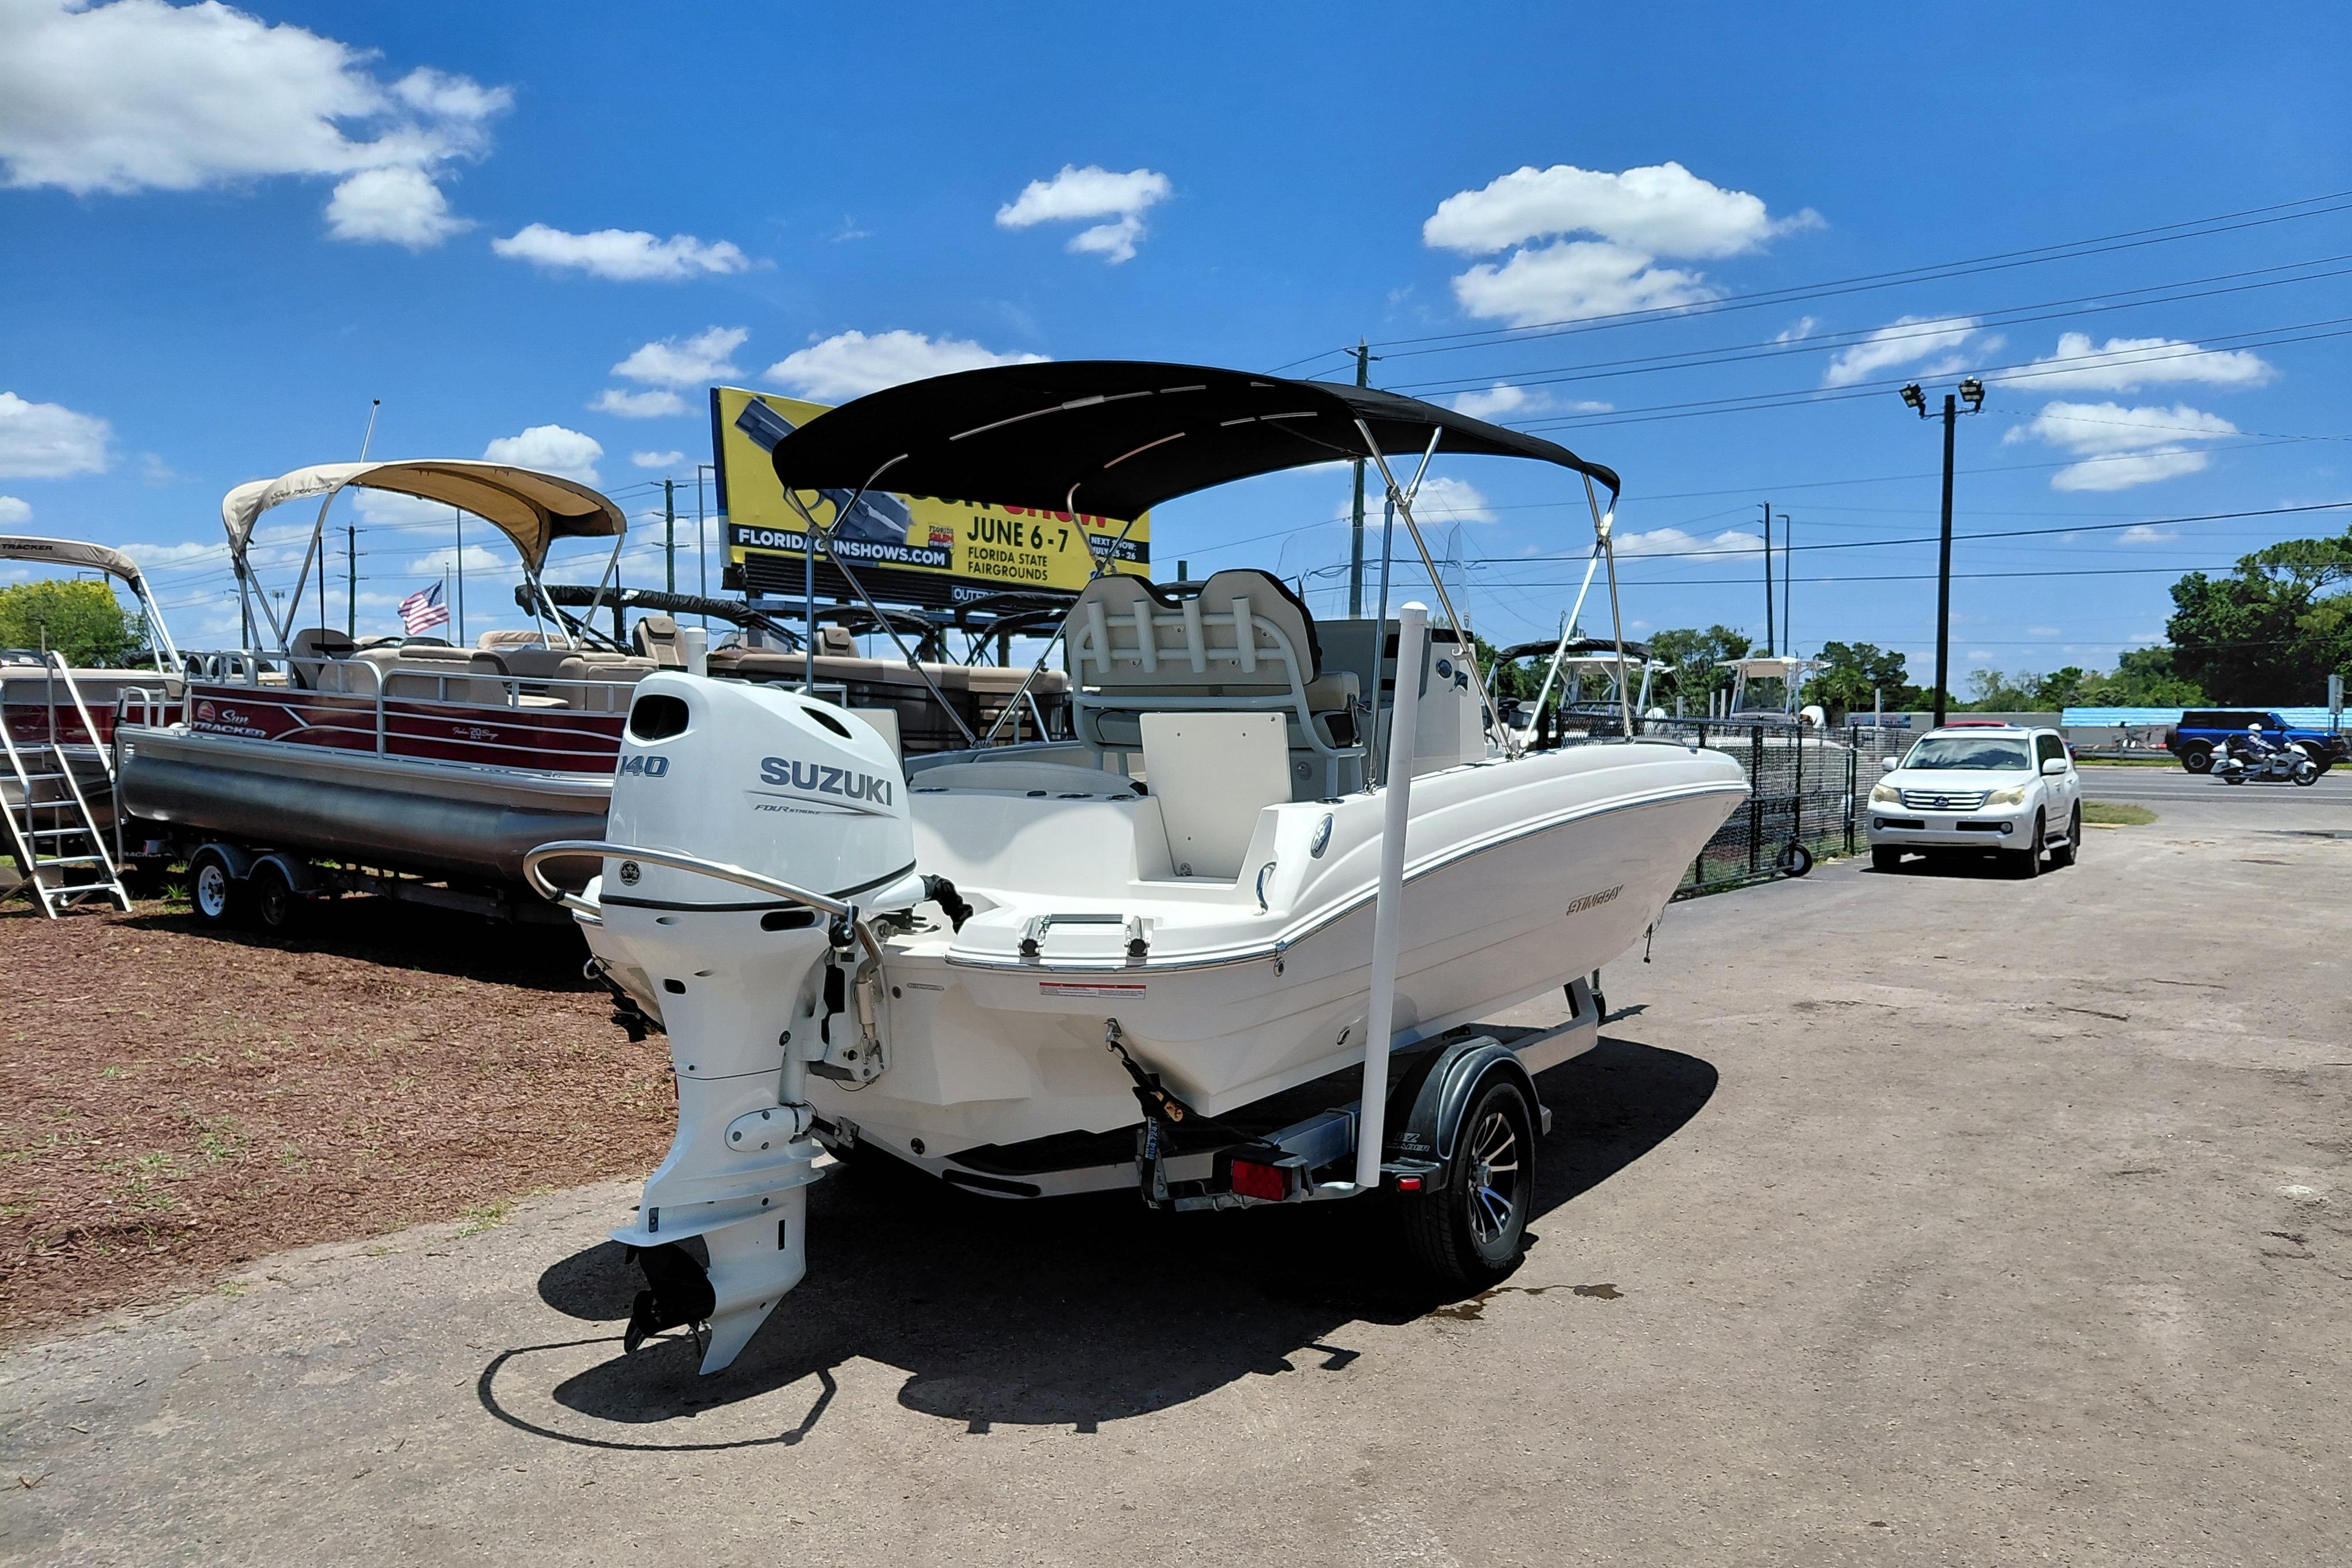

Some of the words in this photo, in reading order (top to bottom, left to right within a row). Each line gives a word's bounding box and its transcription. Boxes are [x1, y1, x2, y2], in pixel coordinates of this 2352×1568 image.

[967, 516, 1023, 547] JUNE
[1031, 525, 1043, 549] 6
[1058, 529, 1068, 552] 7
[1091, 537, 1110, 546] NEXT
[1111, 539, 1137, 551] SOW:
[968, 546, 1015, 564] FLORIDA
[1019, 553, 1047, 567] STATE
[1093, 546, 1109, 556] JULY
[1126, 551, 1136, 560] 26
[968, 561, 1048, 581] FAIRGROUNDS
[219, 709, 250, 725] Sun
[192, 721, 267, 738] TRACKER
[619, 755, 669, 778] 140
[760, 756, 892, 807] SUZUKI
[1566, 884, 1624, 916] STINGRAY
[1394, 1132, 1420, 1143] EZ
